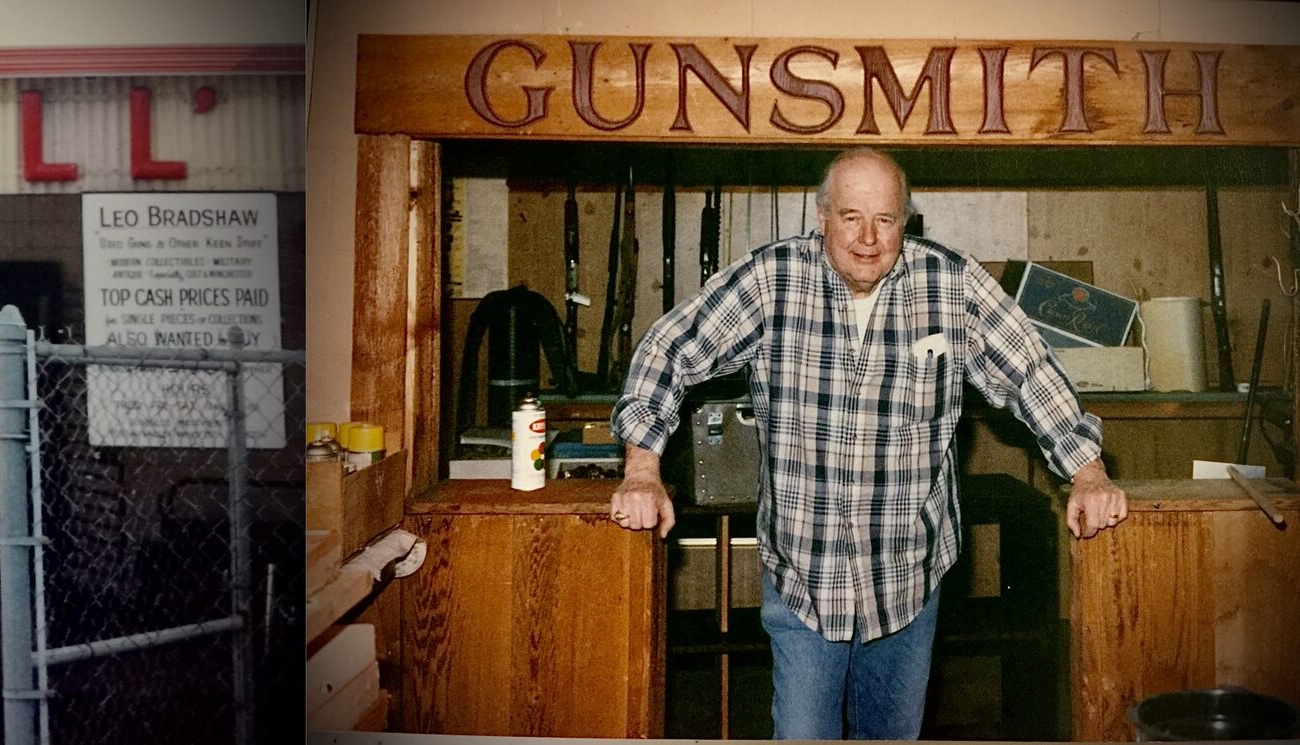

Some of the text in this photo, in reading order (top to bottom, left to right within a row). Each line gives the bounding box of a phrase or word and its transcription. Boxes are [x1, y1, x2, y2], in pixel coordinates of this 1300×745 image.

[464, 38, 1228, 136] GUNSMITH
[100, 205, 259, 228] LEO BRADSHAW
[100, 287, 270, 308] TOP CASH PRICES PAID
[120, 312, 155, 326] SINGLE
[160, 313, 196, 326] PIECES
[106, 331, 148, 347] ALSO
[154, 330, 213, 347] WANTED
